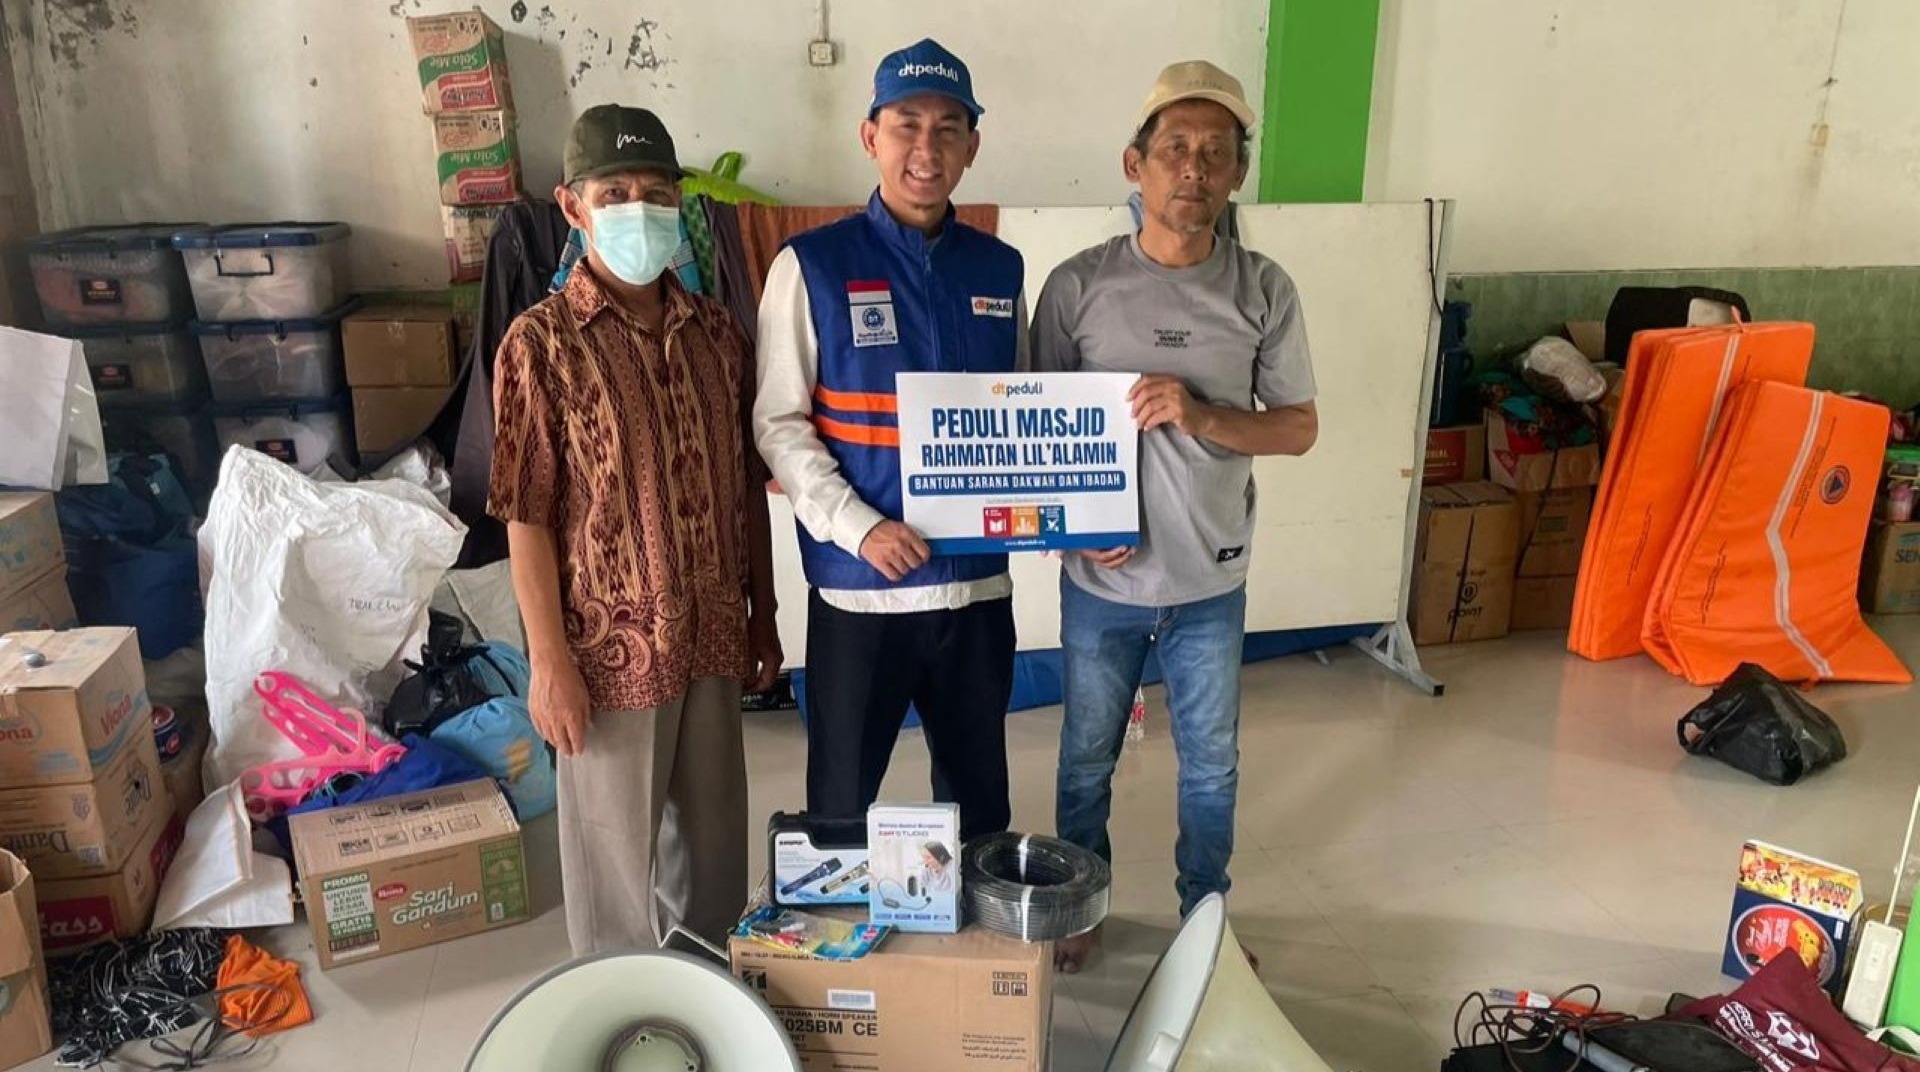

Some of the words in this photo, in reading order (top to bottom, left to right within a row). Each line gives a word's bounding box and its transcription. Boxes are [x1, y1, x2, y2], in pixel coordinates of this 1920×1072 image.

[897, 62, 959, 82] dtpeduli
[974, 299, 1012, 313] dtpeduli
[992, 381, 1043, 398] dtpeduli
[931, 408, 1009, 438] PEDULI
[1016, 407, 1105, 437] MASJID
[921, 443, 1018, 467] RAHMATAN
[914, 475, 965, 490] BANTUAN
[968, 475, 1009, 489] SARANA
[1012, 474, 1055, 488] DAKWAH
[1059, 474, 1079, 487] DAN
[1083, 473, 1120, 487] IBADAH
[323, 873, 368, 890] PROMO
[409, 881, 454, 907] Sari
[392, 892, 479, 925] Gandum
[331, 914, 373, 930] GRATIS
[781, 1019, 843, 1034] 025BM
[853, 1022, 878, 1036] CE
